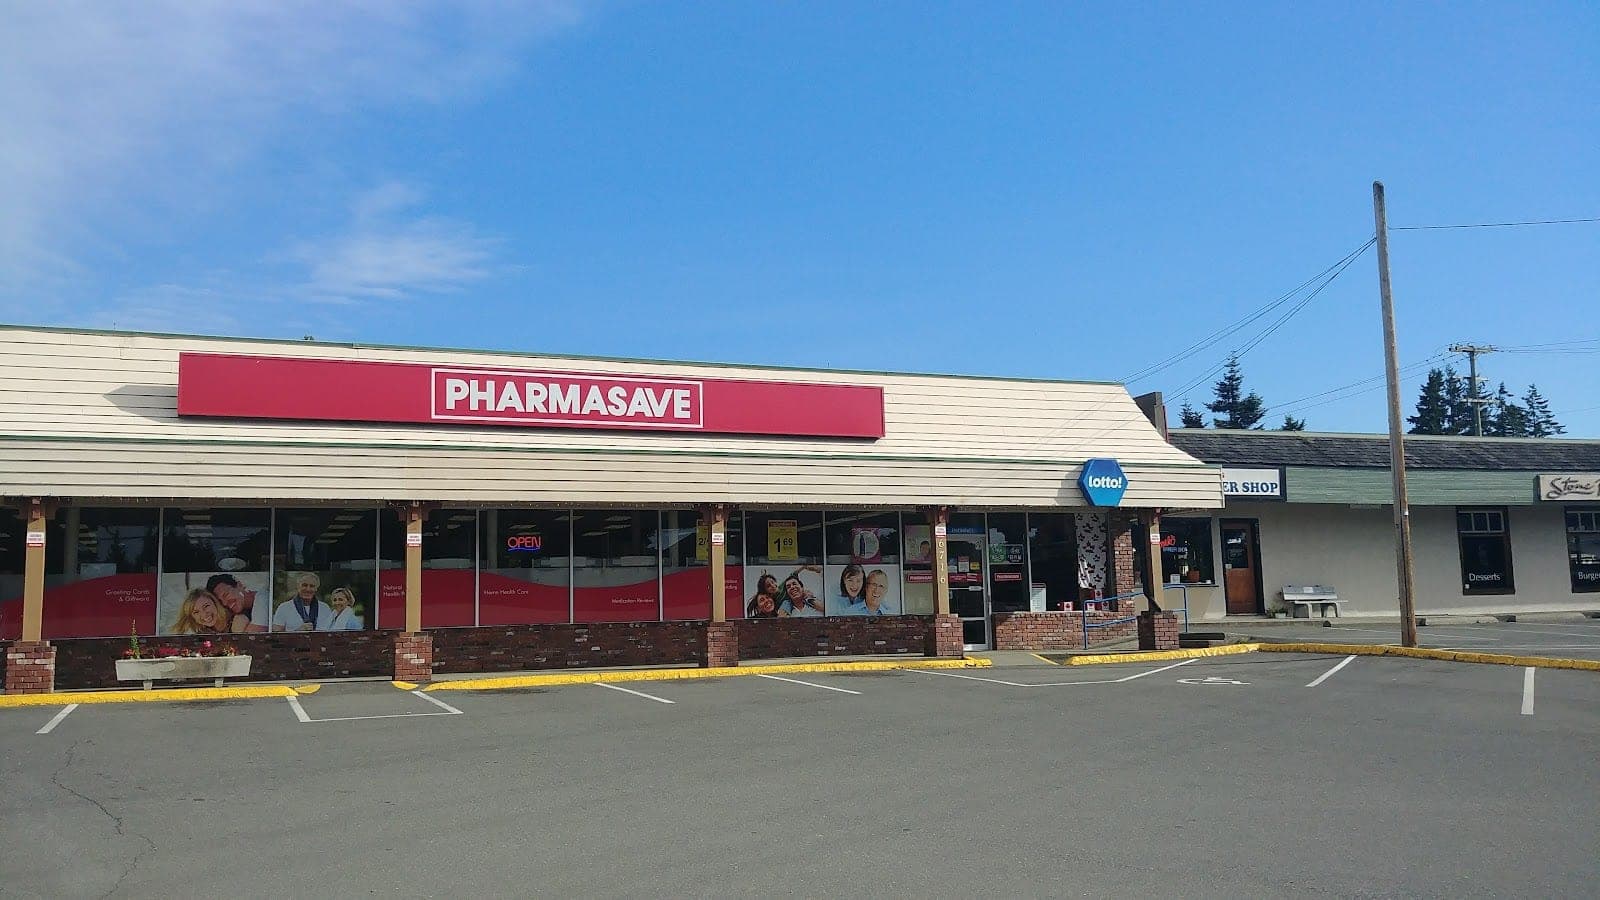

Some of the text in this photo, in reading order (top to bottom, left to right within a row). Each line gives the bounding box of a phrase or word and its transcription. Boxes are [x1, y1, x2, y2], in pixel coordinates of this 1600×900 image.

[445, 378, 691, 418] PHARMASAVE
[1088, 475, 1122, 489] lotto!
[1242, 482, 1278, 493] SHOP
[507, 536, 541, 549] OPEN
[1468, 572, 1501, 582] Desserts
